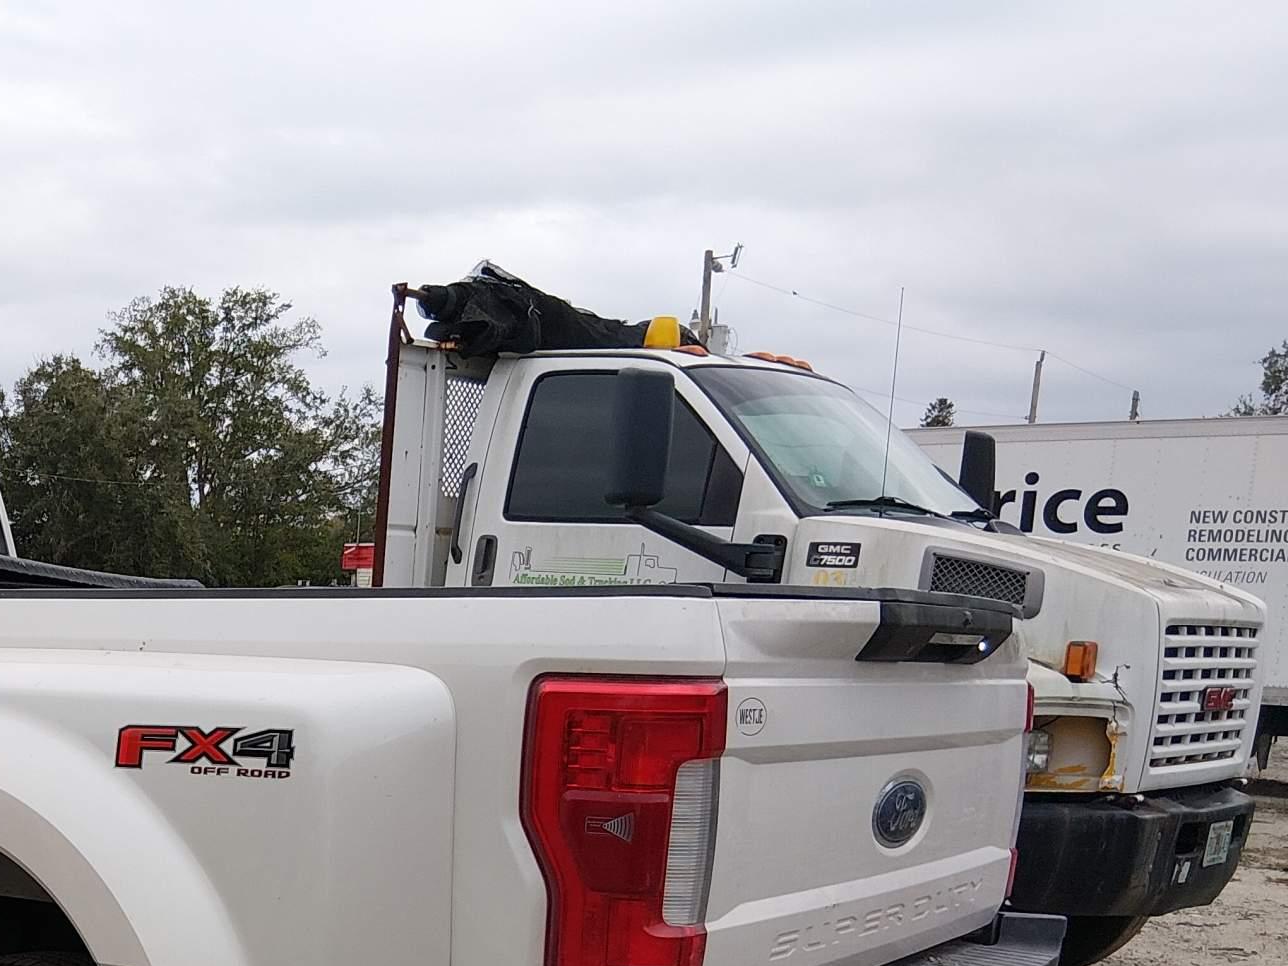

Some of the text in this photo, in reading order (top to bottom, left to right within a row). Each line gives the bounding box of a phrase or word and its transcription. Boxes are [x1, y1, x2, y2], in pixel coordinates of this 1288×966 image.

[1189, 509, 1288, 524] NEW CONST
[817, 545, 852, 554] GMC
[1185, 547, 1288, 562] COMMERCIA
[512, 573, 558, 585] Affordable
[114, 724, 296, 769] FX4
[190, 766, 291, 779] OFF ROAD
